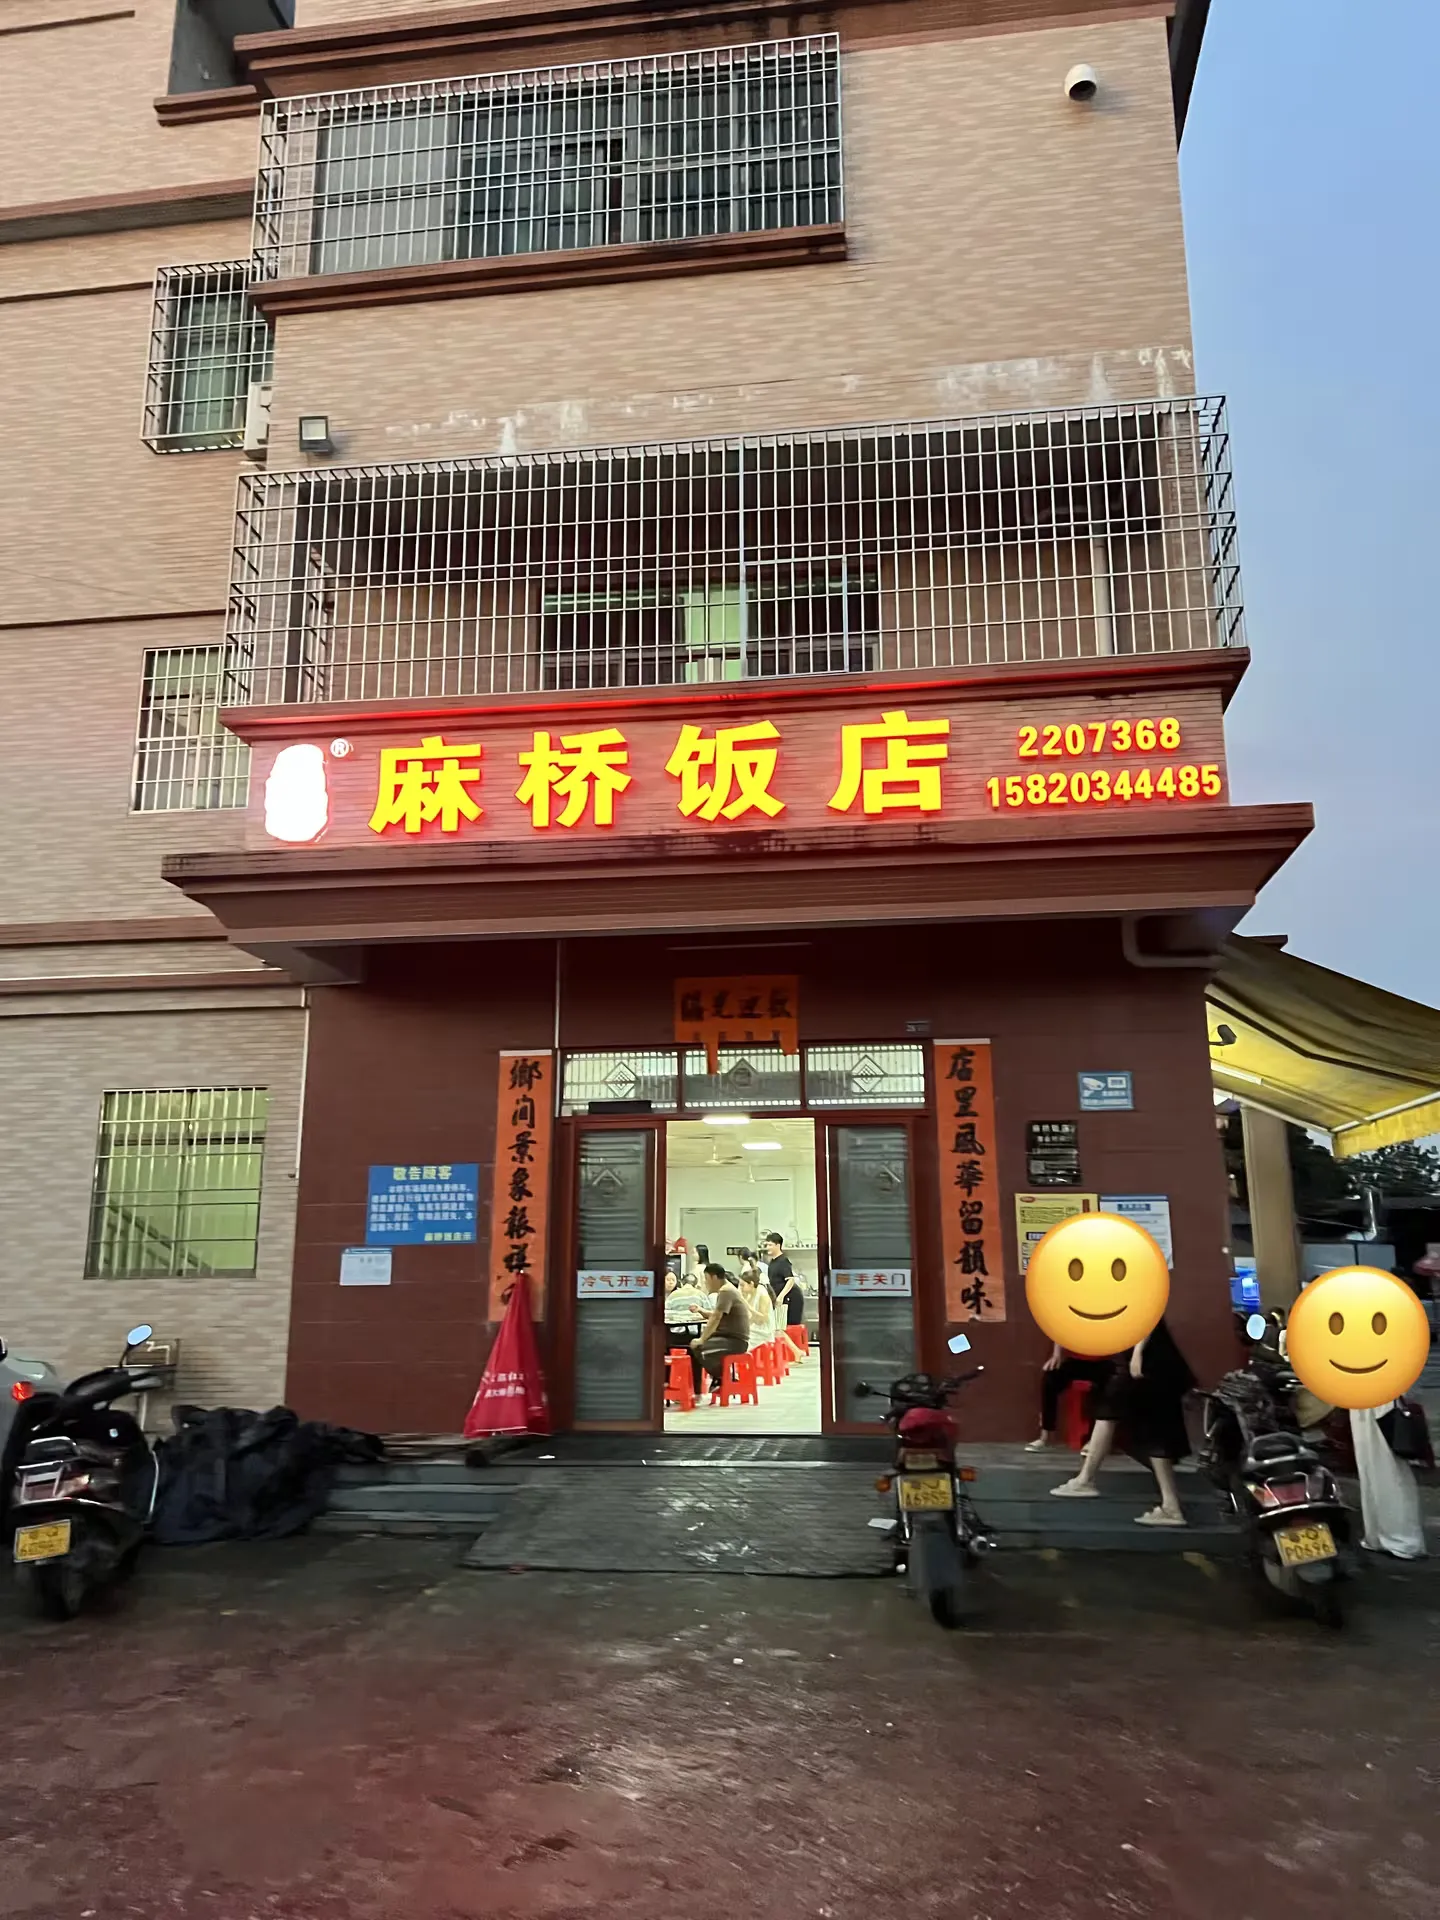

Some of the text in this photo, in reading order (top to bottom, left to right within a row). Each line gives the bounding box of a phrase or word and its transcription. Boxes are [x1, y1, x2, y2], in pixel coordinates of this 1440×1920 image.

[1018, 717, 1181, 757] 2207368
[368, 710, 950, 833] 麻桥饭店
[986, 764, 1222, 808] 15820344485
[581, 1275, 649, 1288] 冷气开放
